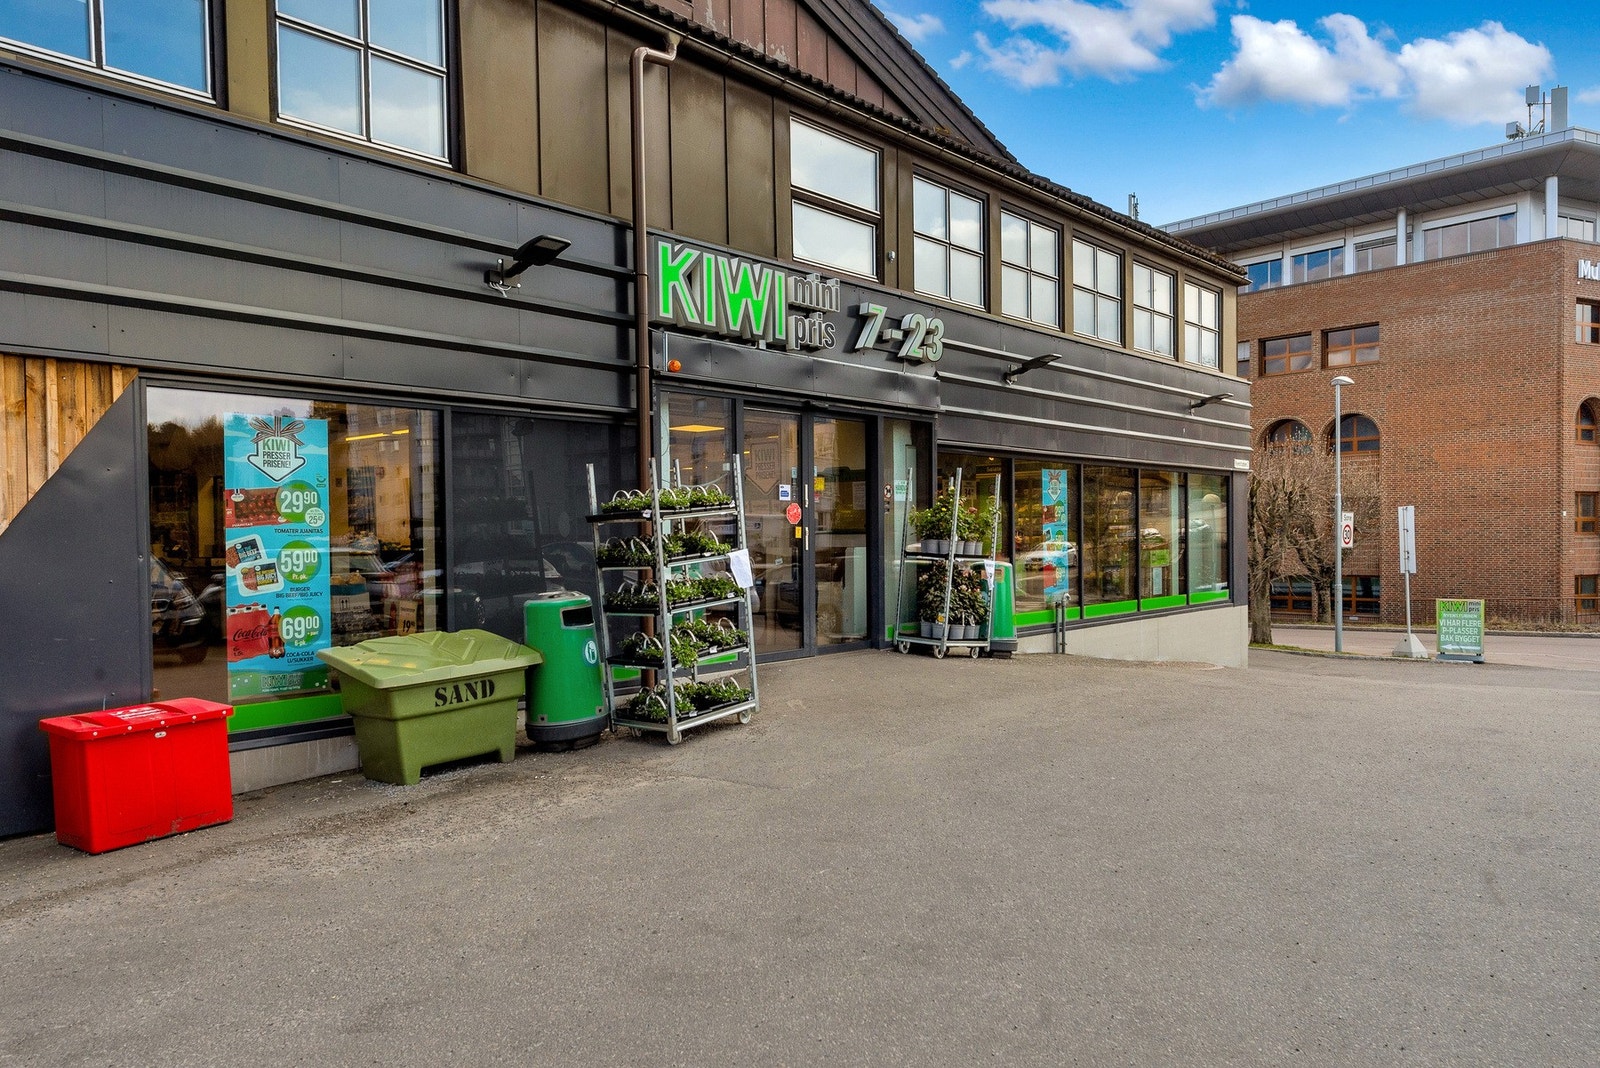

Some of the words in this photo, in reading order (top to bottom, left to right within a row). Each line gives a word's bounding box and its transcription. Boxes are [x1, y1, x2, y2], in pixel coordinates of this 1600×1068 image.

[657, 240, 788, 342] KIWI
[790, 273, 841, 313] mini
[790, 312, 837, 350] pris
[855, 302, 946, 363] 7-23
[262, 439, 291, 451] KIWI
[262, 451, 291, 460] PRESSER
[262, 460, 291, 469] PRISENE!
[1344, 529, 1350, 540] 30
[1440, 601, 1468, 612] KIWI
[1442, 627, 1479, 635] P-PLASSER
[1455, 635, 1480, 643] BYGGET
[434, 679, 495, 708] SAND
